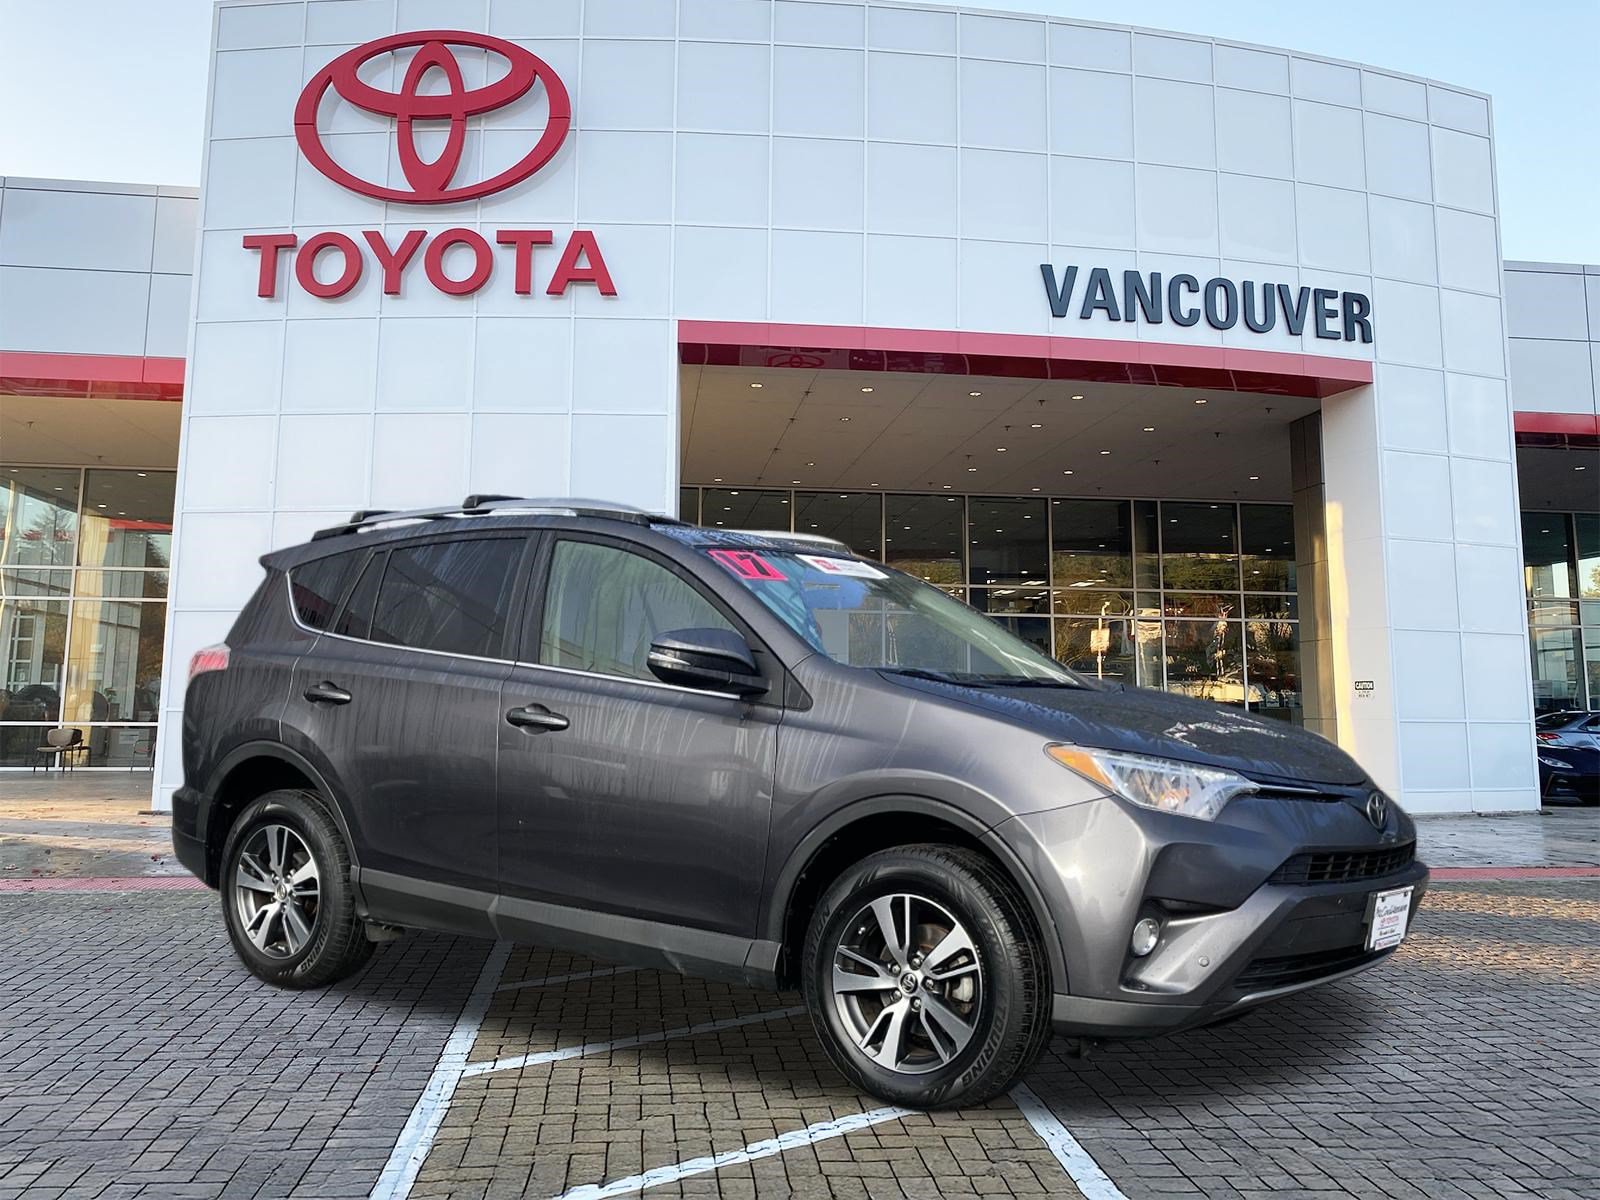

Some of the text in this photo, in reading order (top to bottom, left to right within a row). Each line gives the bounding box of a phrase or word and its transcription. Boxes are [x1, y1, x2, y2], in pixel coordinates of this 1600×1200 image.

[243, 228, 617, 298] TOYOTA
[1040, 264, 1373, 343] VANCOUVER
[715, 552, 772, 577] 17
